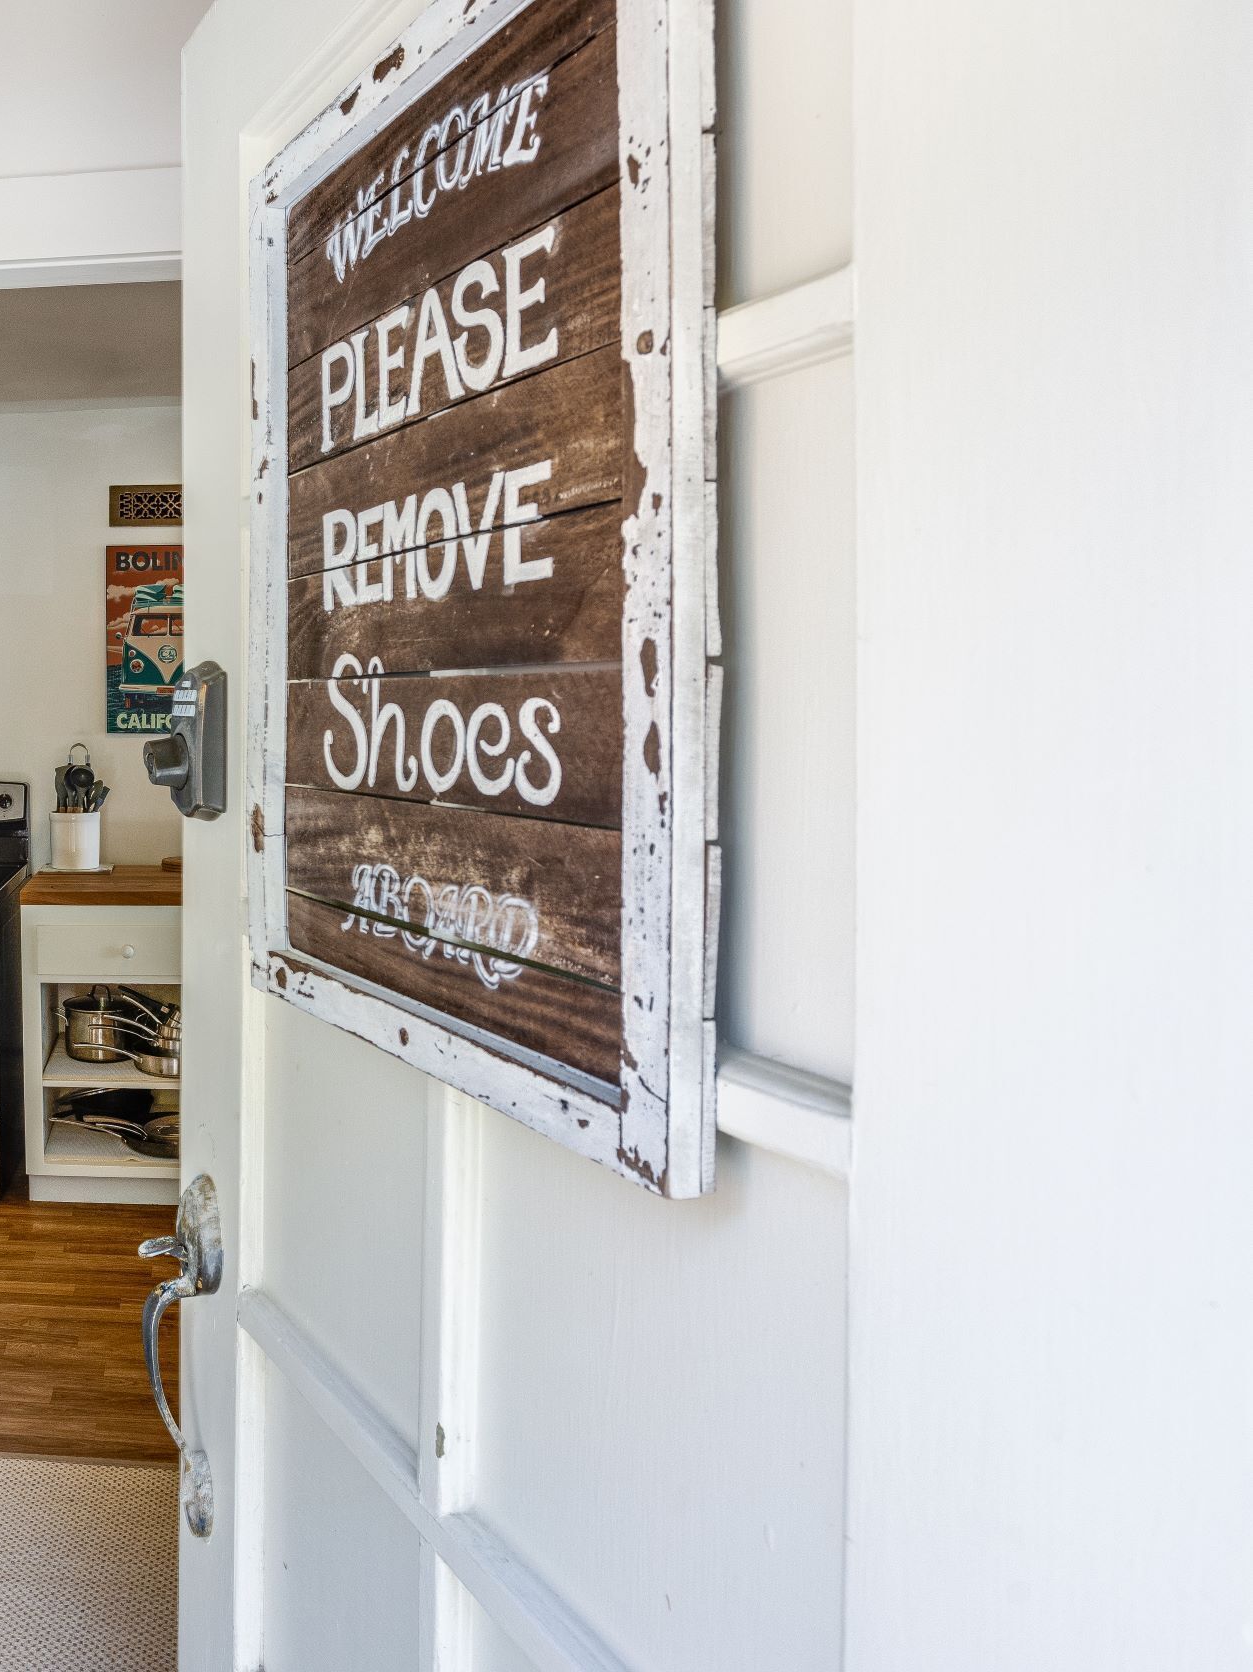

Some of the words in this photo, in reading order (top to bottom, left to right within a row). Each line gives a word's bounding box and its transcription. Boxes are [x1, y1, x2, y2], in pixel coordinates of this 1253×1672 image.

[325, 75, 550, 284] WELCOME
[321, 225, 559, 454] PLEASE
[322, 459, 554, 612] REMOVE
[323, 653, 563, 806] Shoes
[341, 863, 539, 990] ABOARD
